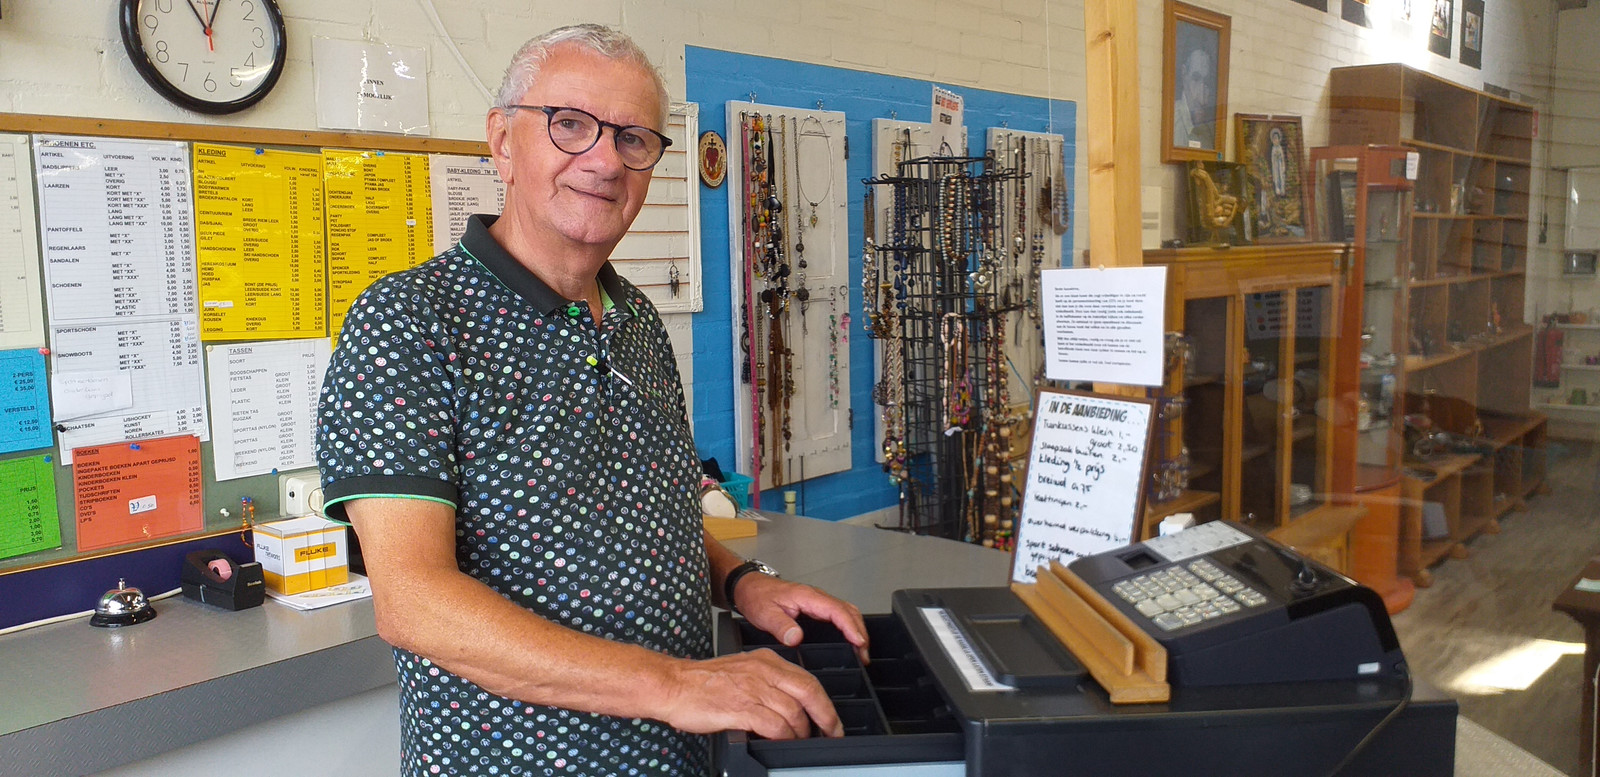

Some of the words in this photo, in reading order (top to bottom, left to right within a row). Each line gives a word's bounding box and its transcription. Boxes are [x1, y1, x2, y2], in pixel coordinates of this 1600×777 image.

[241, 0, 254, 21] 2
[144, 15, 158, 36] 9
[252, 27, 265, 48] 3
[156, 40, 169, 63] 8
[243, 52, 256, 69] 4
[177, 62, 189, 82] 7
[203, 72, 217, 93] 6
[229, 67, 243, 88] 5
[198, 148, 226, 157] KLEDING
[1049, 401, 1059, 413] IN
[1060, 402, 1072, 414] DE
[300, 546, 328, 556] FLUKE
